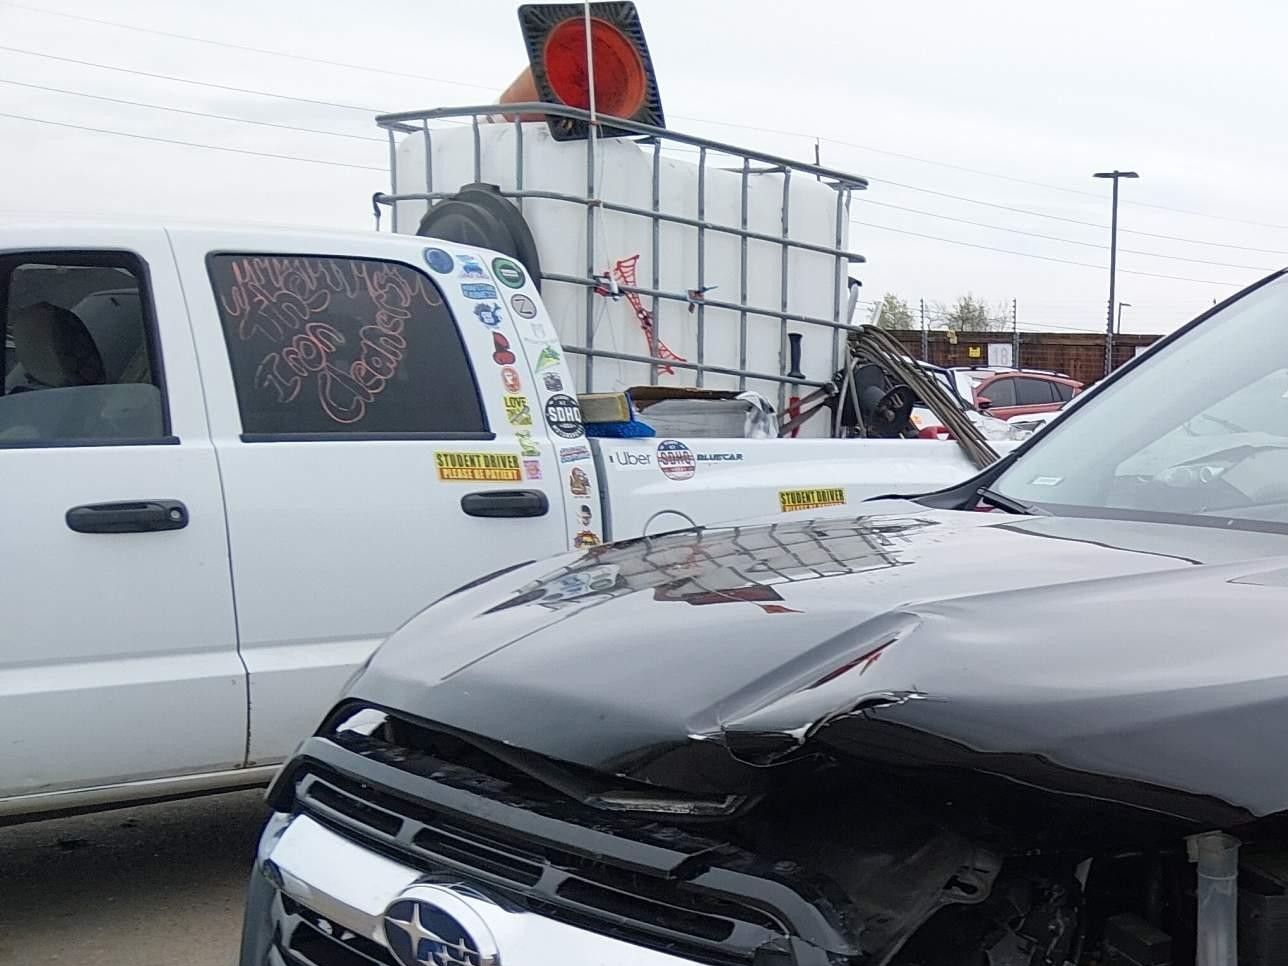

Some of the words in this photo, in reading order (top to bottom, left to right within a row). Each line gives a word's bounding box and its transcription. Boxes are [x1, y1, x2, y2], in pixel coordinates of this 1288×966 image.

[436, 454, 481, 468] STUDENT
[484, 455, 520, 468] DRIVER
[617, 451, 651, 466] Uber
[697, 453, 744, 461] BLUECAR
[442, 468, 473, 479] PLEASE
[474, 469, 484, 479] BE
[484, 470, 519, 480] PATIENT
[780, 490, 814, 504] STUDENT
[815, 489, 844, 502] DRIVER
